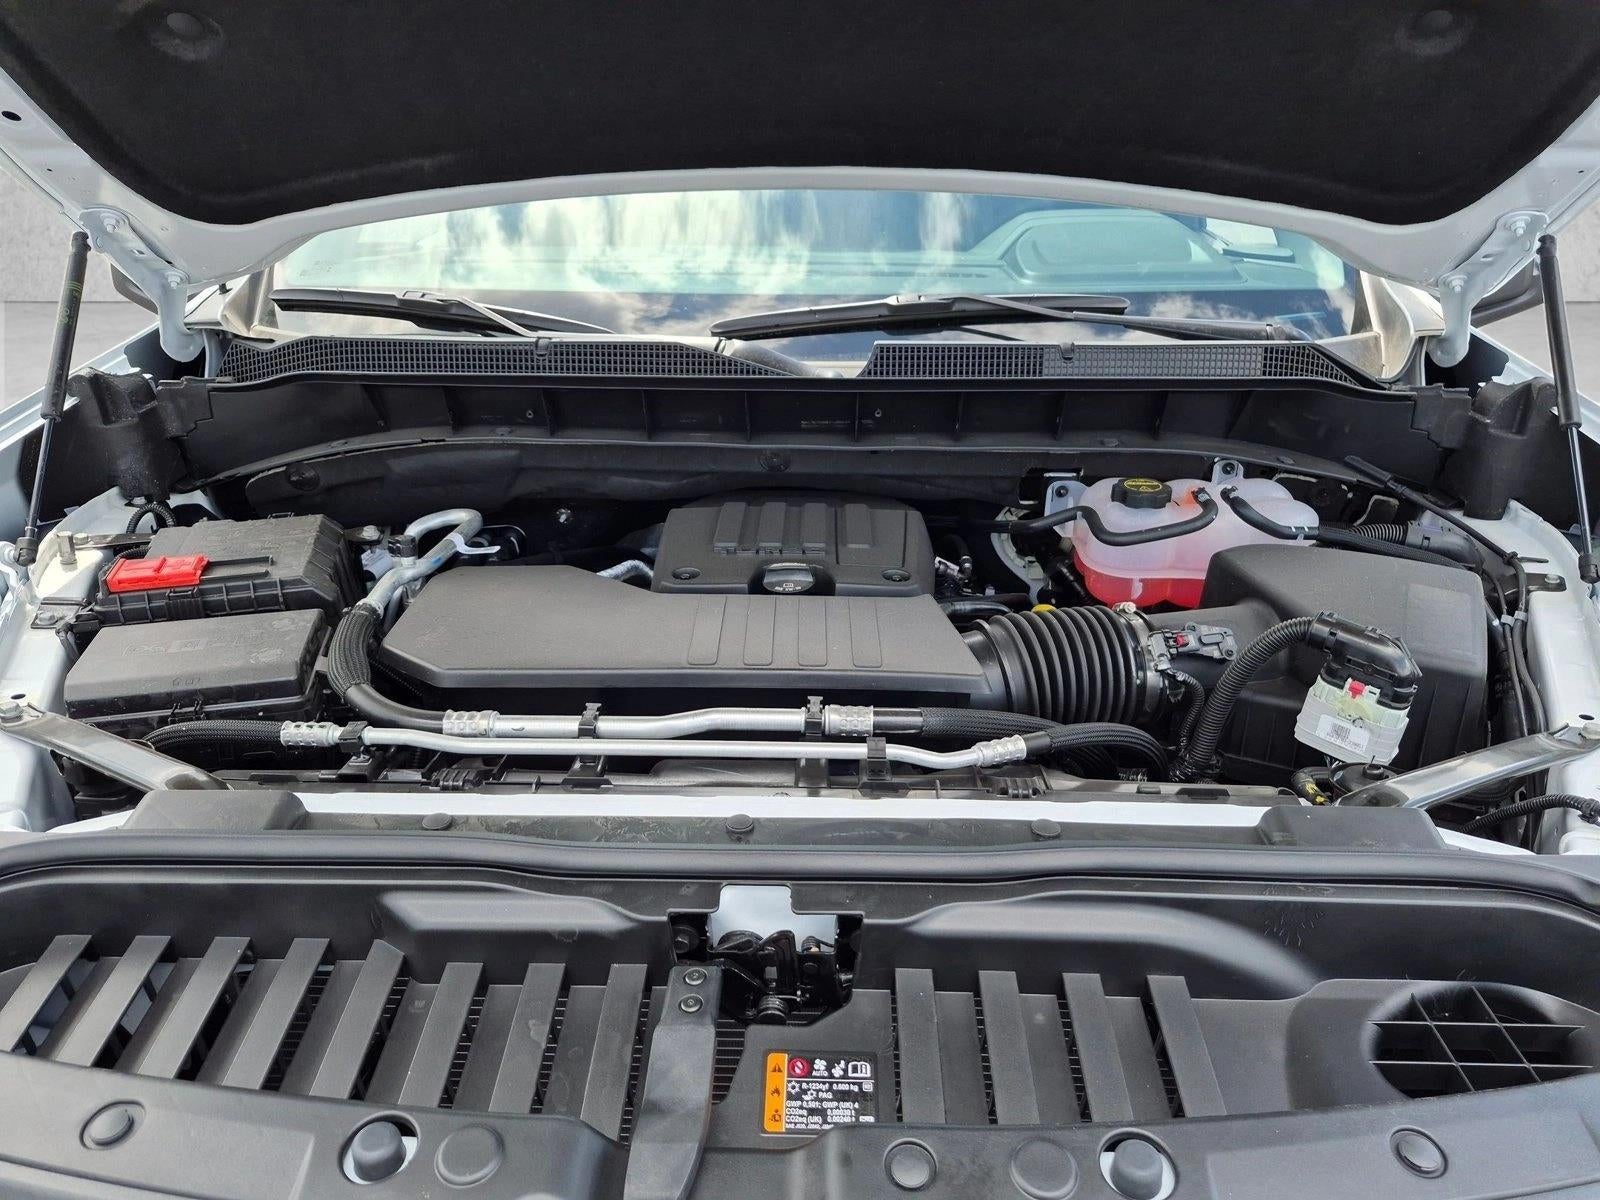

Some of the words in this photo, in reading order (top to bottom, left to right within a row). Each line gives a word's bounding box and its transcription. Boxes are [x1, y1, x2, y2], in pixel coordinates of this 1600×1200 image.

[802, 1082, 829, 1091] R-1234yf
[850, 1083, 859, 1092] kg
[818, 1091, 833, 1099] PAG
[786, 1100, 802, 1108] GWP
[838, 1101, 853, 1109] (UK)
[786, 1108, 807, 1116] CO2eq
[785, 1115, 807, 1123] CO2eq
[807, 1115, 822, 1124] (UK)
